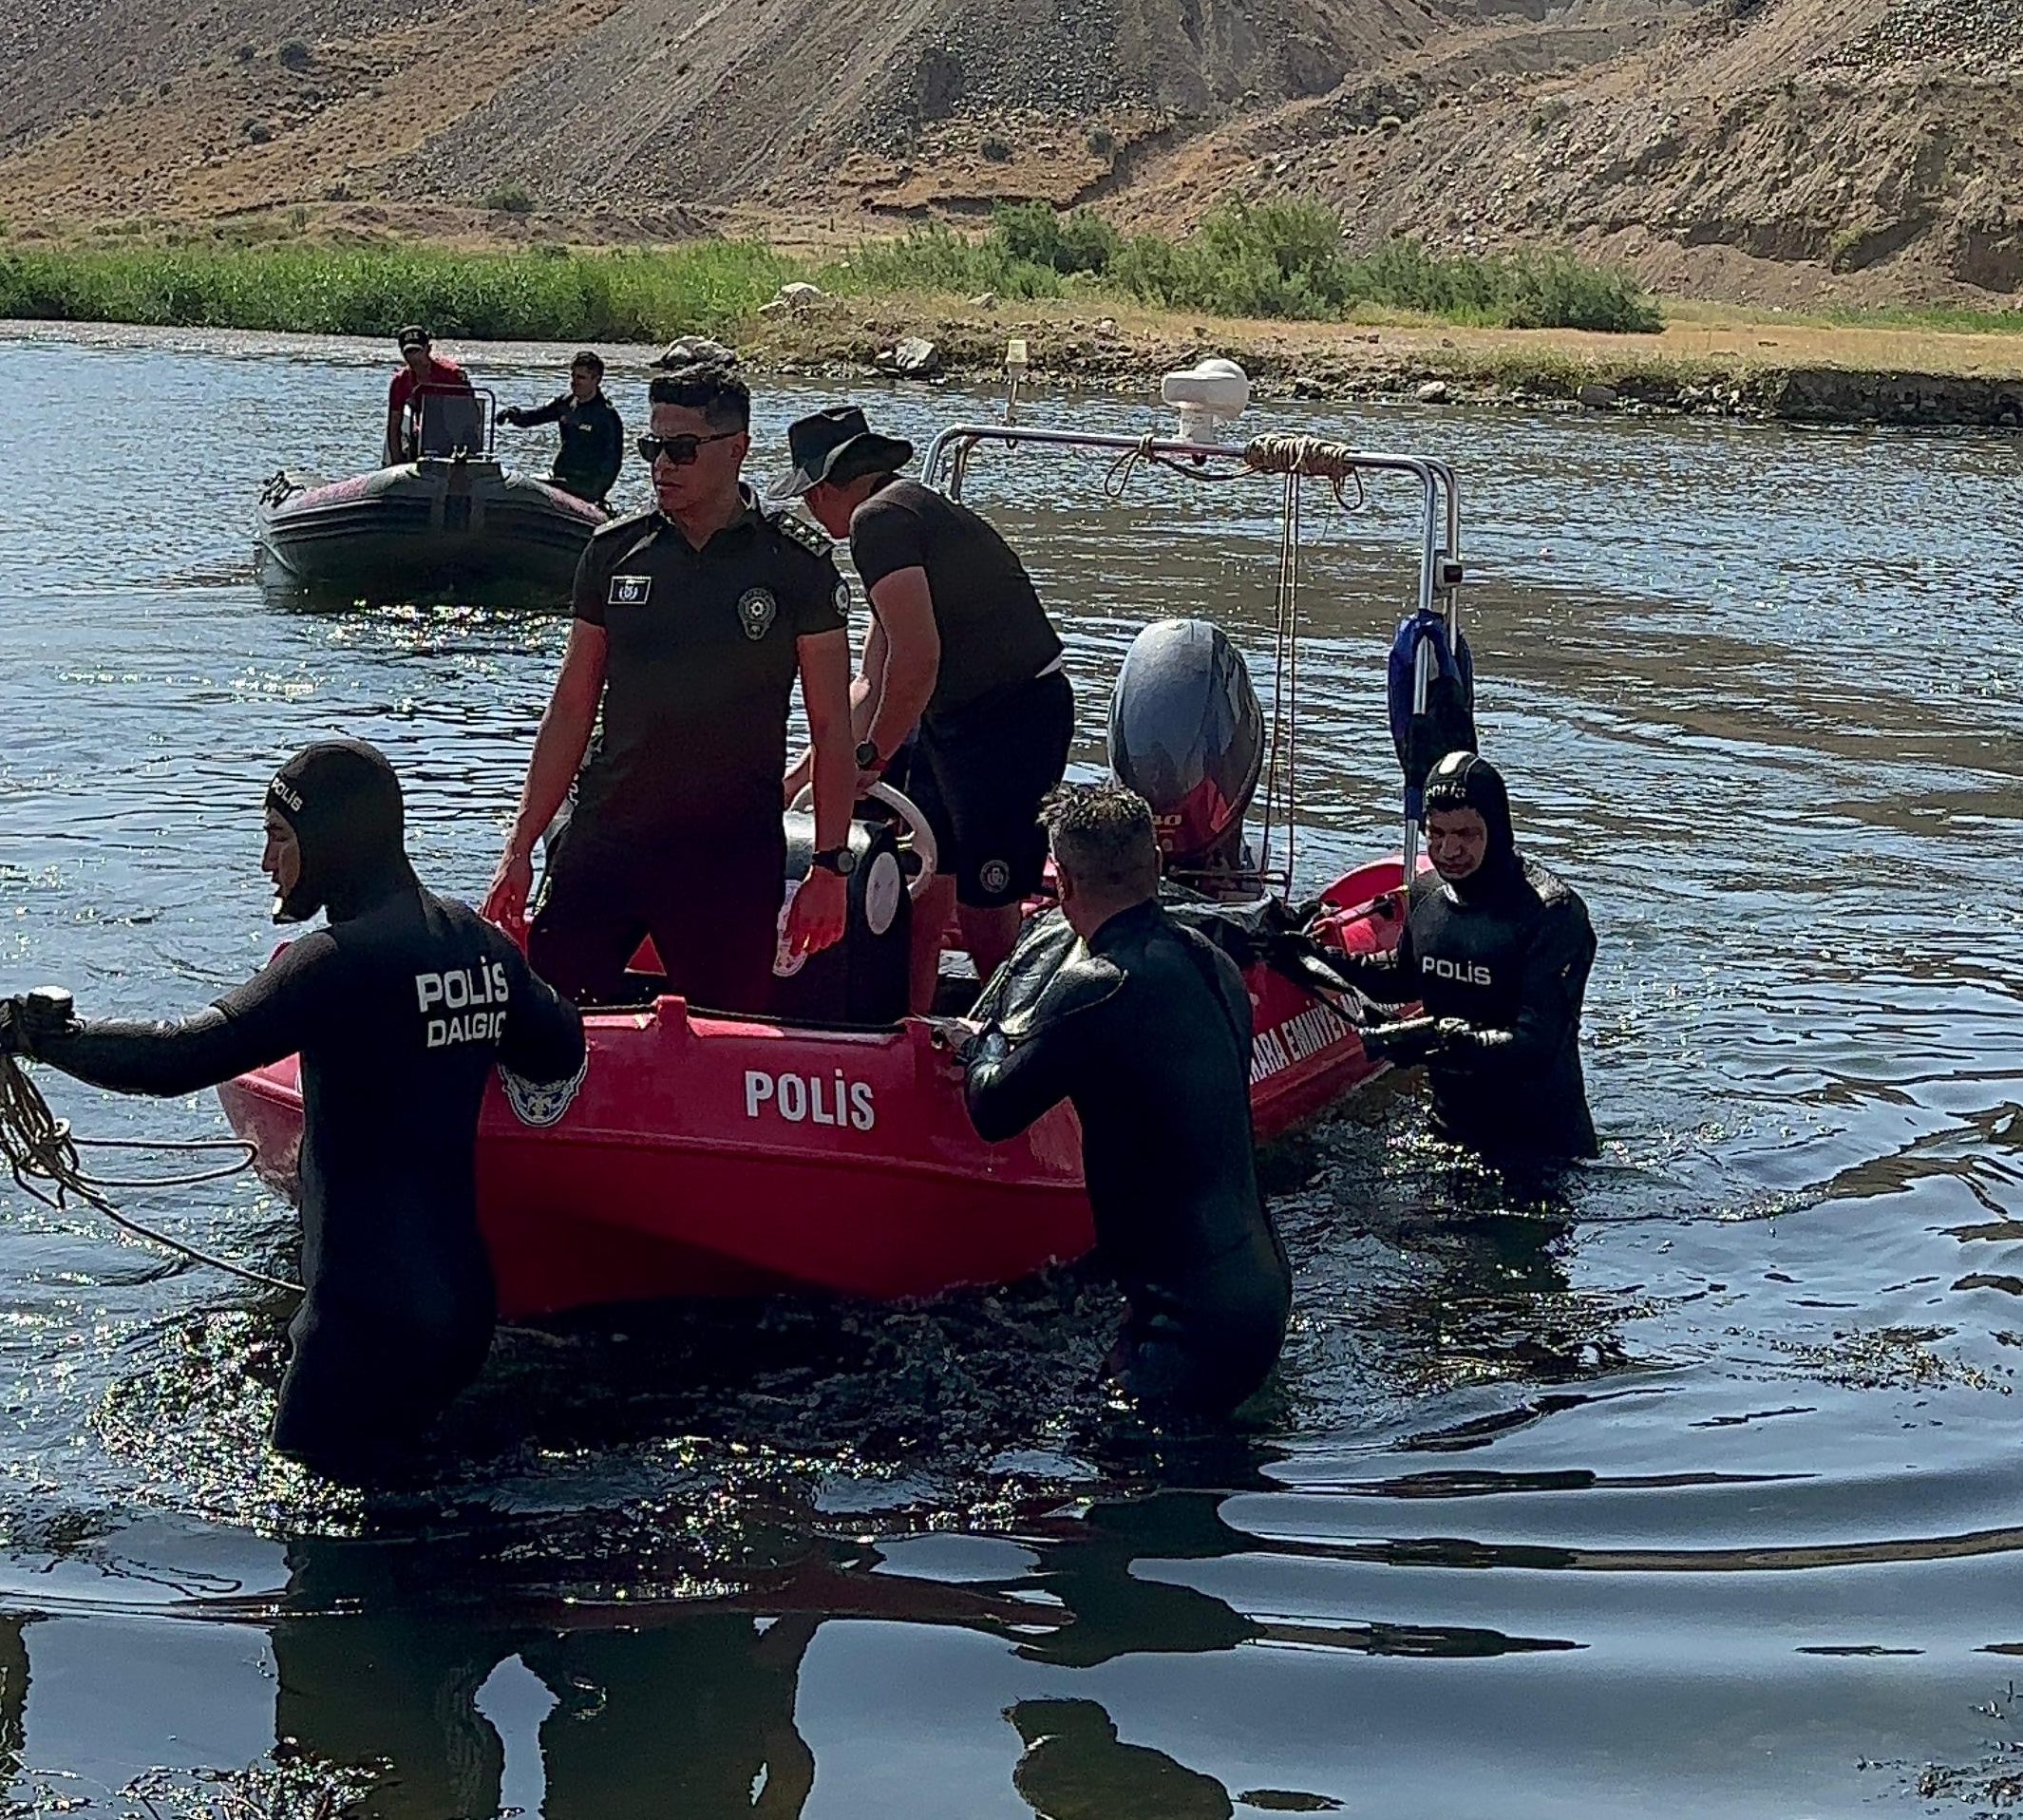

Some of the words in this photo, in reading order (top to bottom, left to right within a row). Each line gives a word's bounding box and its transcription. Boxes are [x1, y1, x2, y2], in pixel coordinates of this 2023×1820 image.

[415, 955, 509, 1013] POLİS
[1422, 956, 1492, 985] POLİS
[426, 1010, 507, 1048] DALGIÇ
[744, 1068, 876, 1131] POLİS
